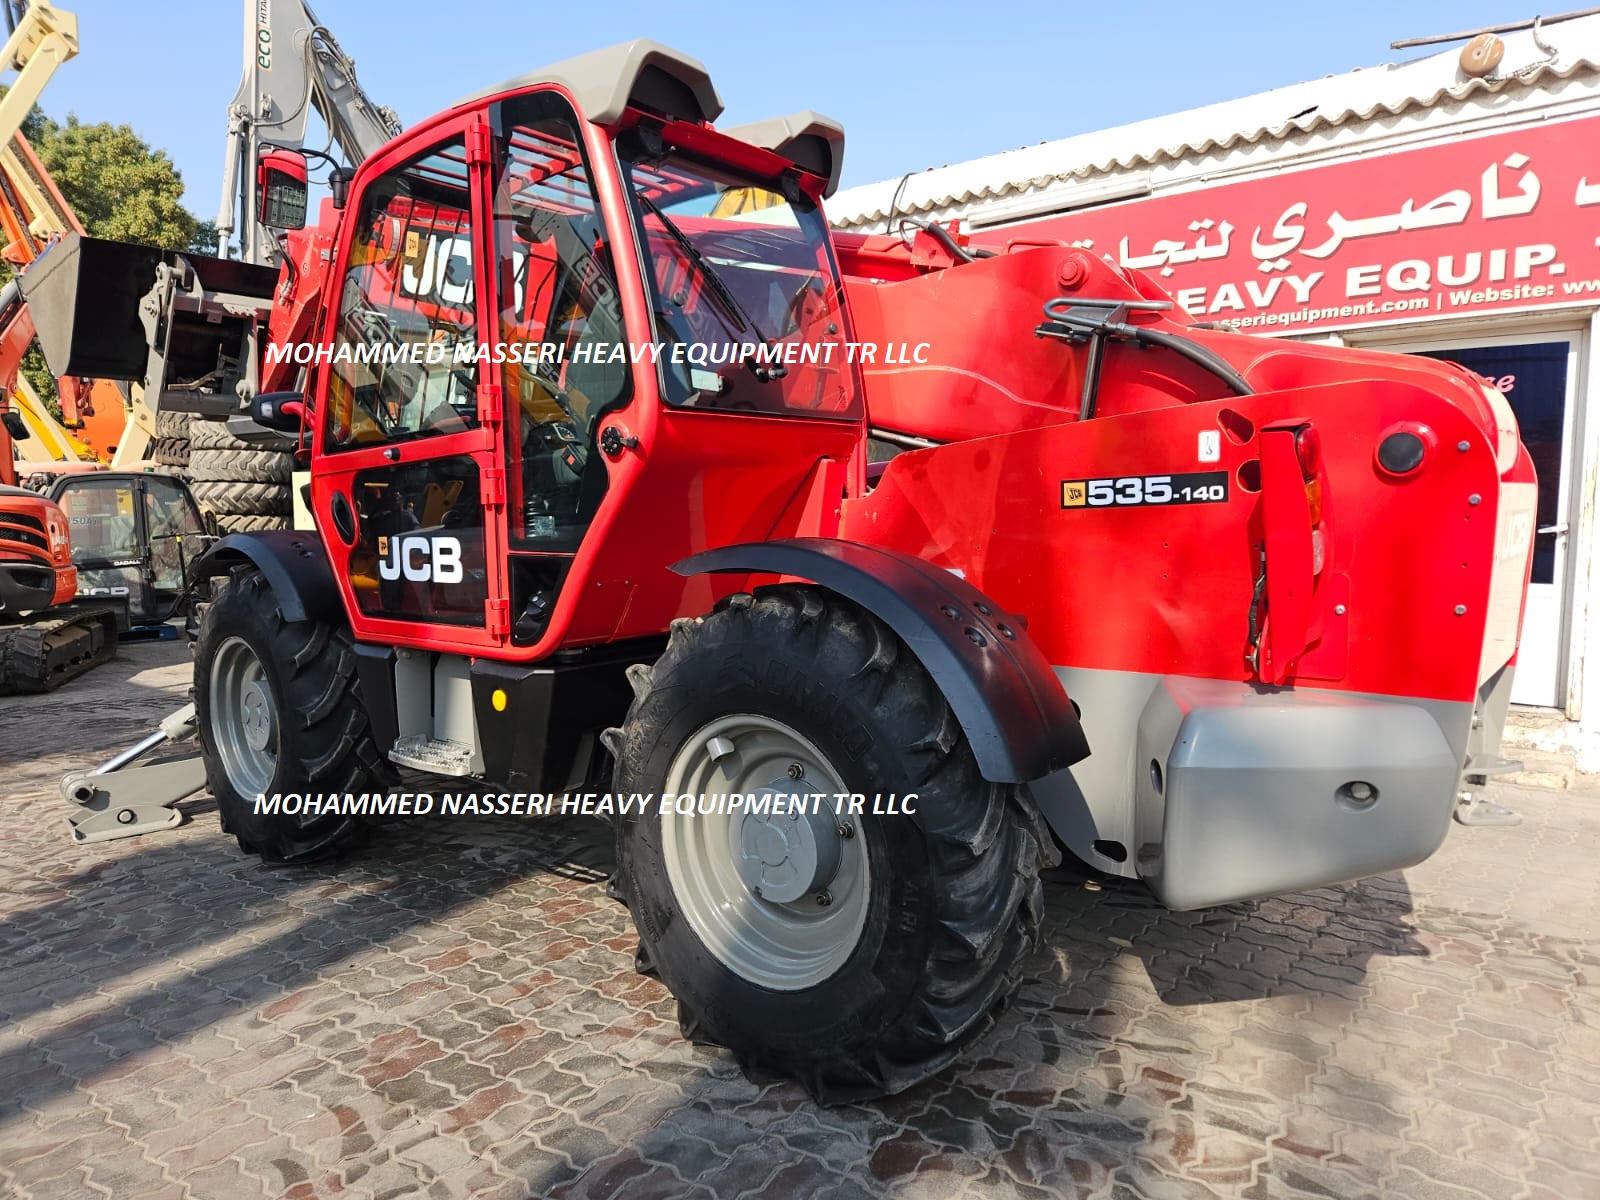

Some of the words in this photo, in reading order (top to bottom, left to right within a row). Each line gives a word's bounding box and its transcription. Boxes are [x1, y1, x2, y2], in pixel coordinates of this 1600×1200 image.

[258, 29, 271, 69] eco
[1251, 152, 1540, 273] ناصري
[1168, 272, 1325, 315] EAVY
[1345, 244, 1566, 298] EQUIP.
[1214, 296, 1430, 328] sseriequipment.com
[1449, 284, 1555, 306] Website:
[379, 536, 464, 583] JCB
